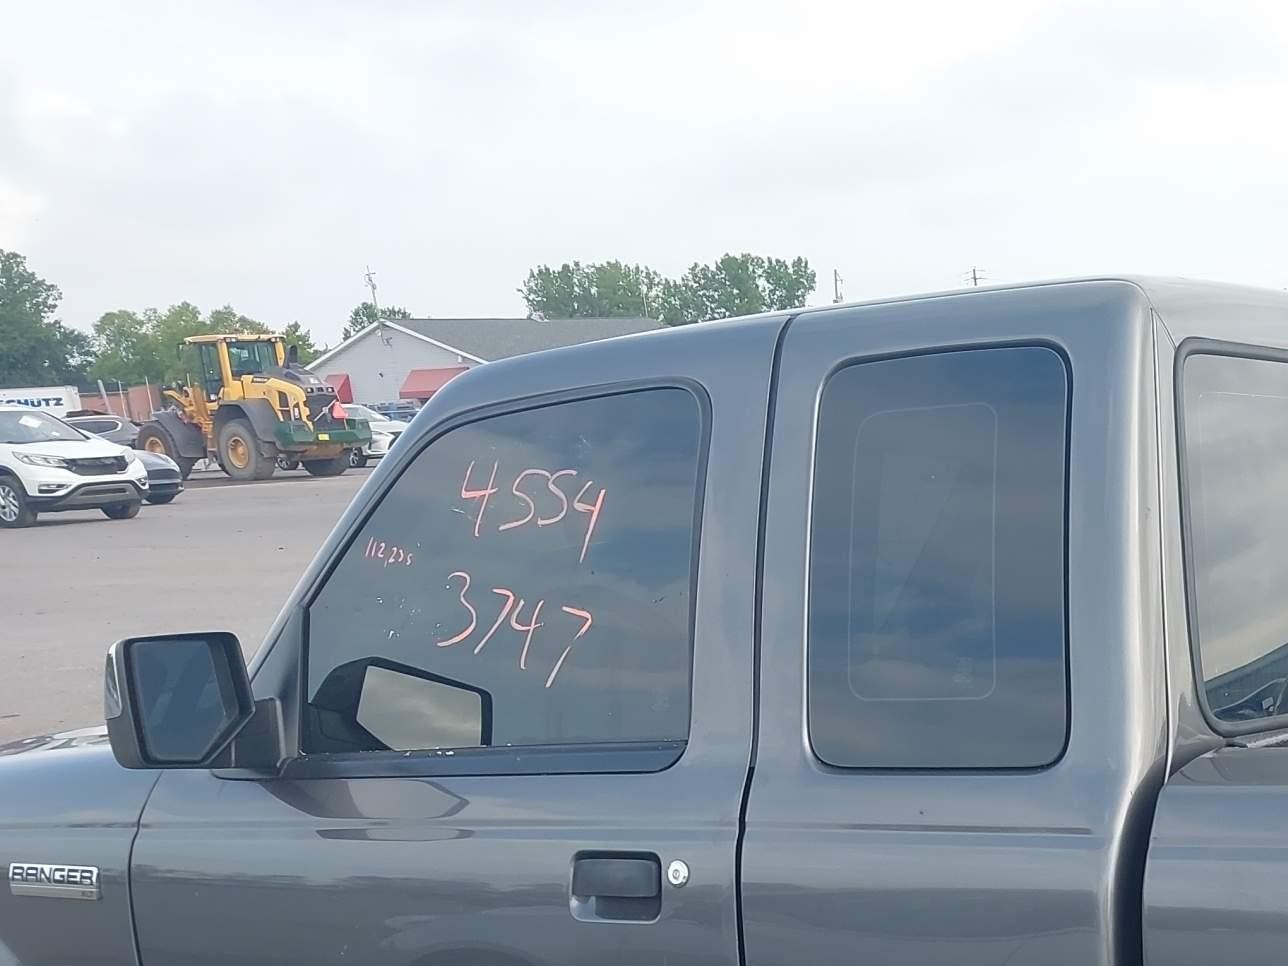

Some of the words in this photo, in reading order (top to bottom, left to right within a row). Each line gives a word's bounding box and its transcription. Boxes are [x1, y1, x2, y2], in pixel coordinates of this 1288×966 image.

[460, 460, 607, 564] 4554
[436, 571, 593, 688] 3747
[11, 864, 95, 886] RANGER
